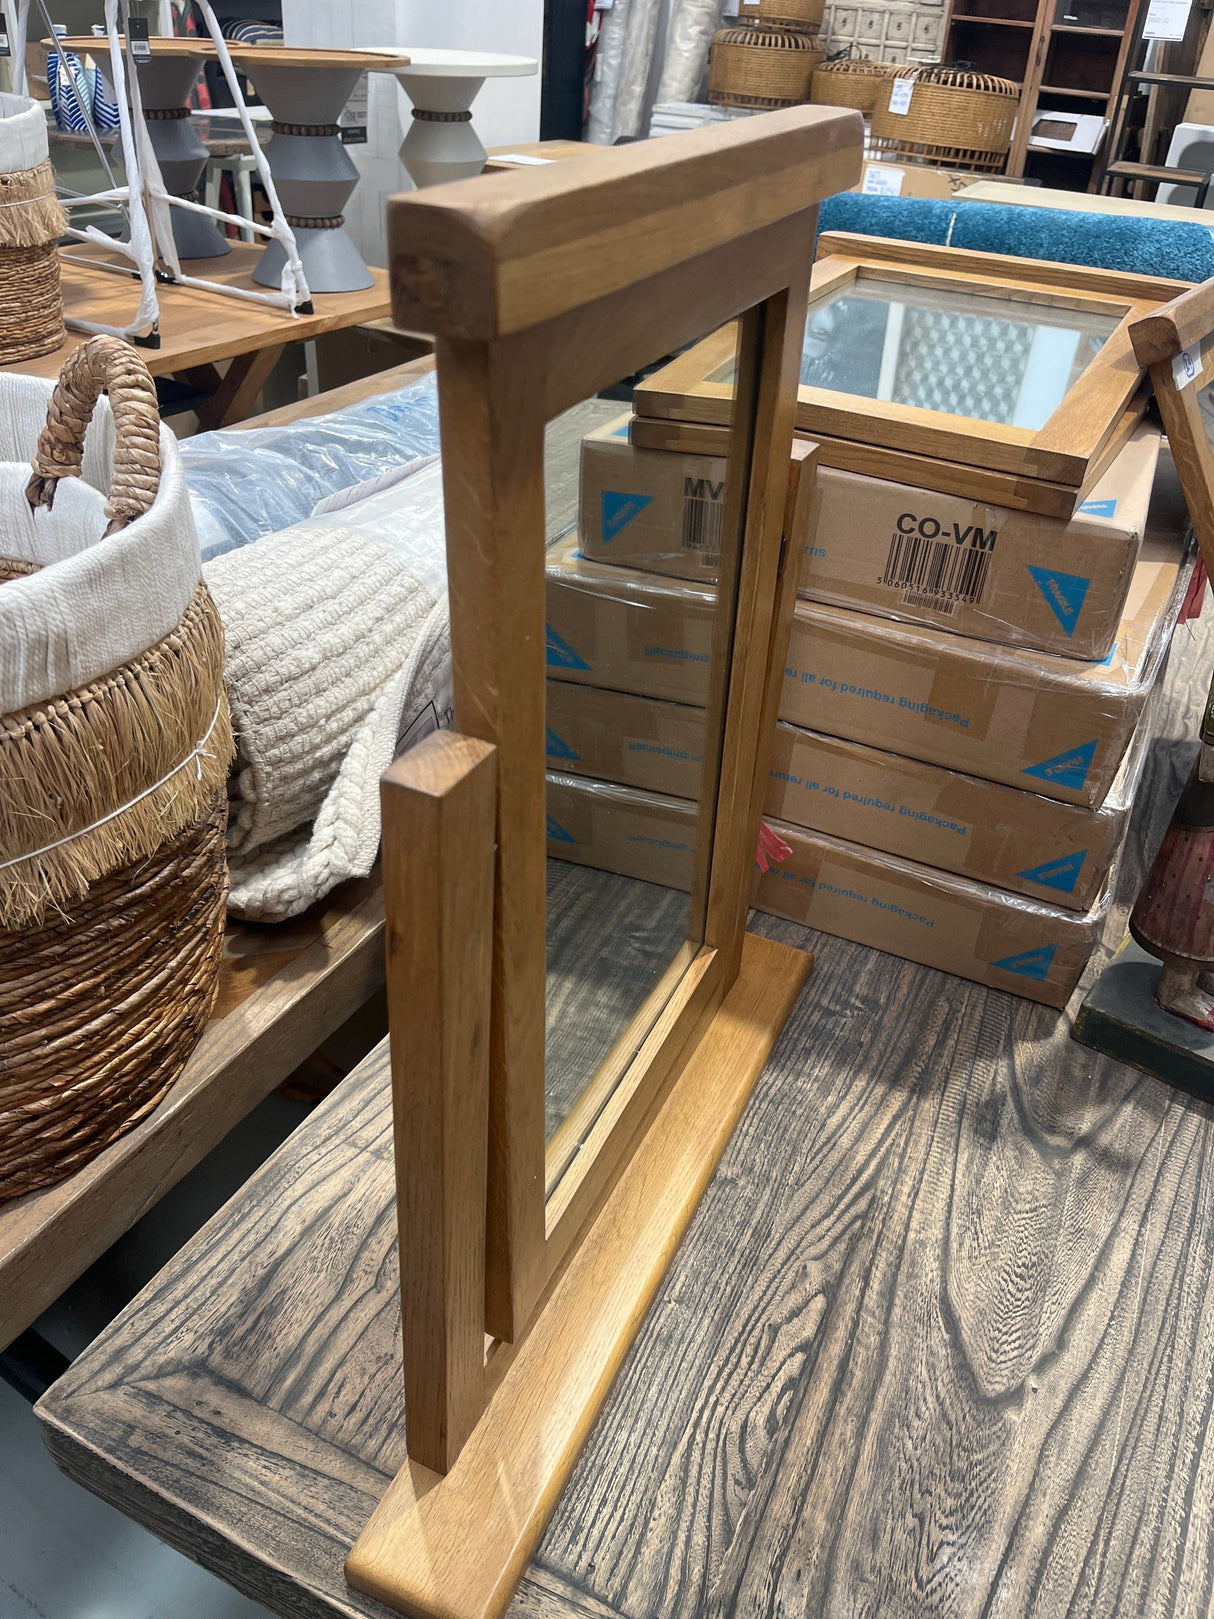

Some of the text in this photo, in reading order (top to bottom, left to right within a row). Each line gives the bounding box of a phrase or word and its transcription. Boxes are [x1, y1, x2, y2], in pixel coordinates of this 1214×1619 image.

[896, 513, 997, 552] CO-VM
[933, 589, 976, 604] 933549
[1046, 578, 1073, 616] FRAGILE
[800, 672, 816, 683] all
[818, 678, 837, 691] for
[840, 683, 895, 704] required
[899, 697, 969, 728] Packaging
[805, 780, 820, 790] all
[822, 786, 840, 798] for
[843, 791, 895, 812] required
[899, 805, 967, 836] Packaging
[783, 871, 935, 928] Packaging required for all
